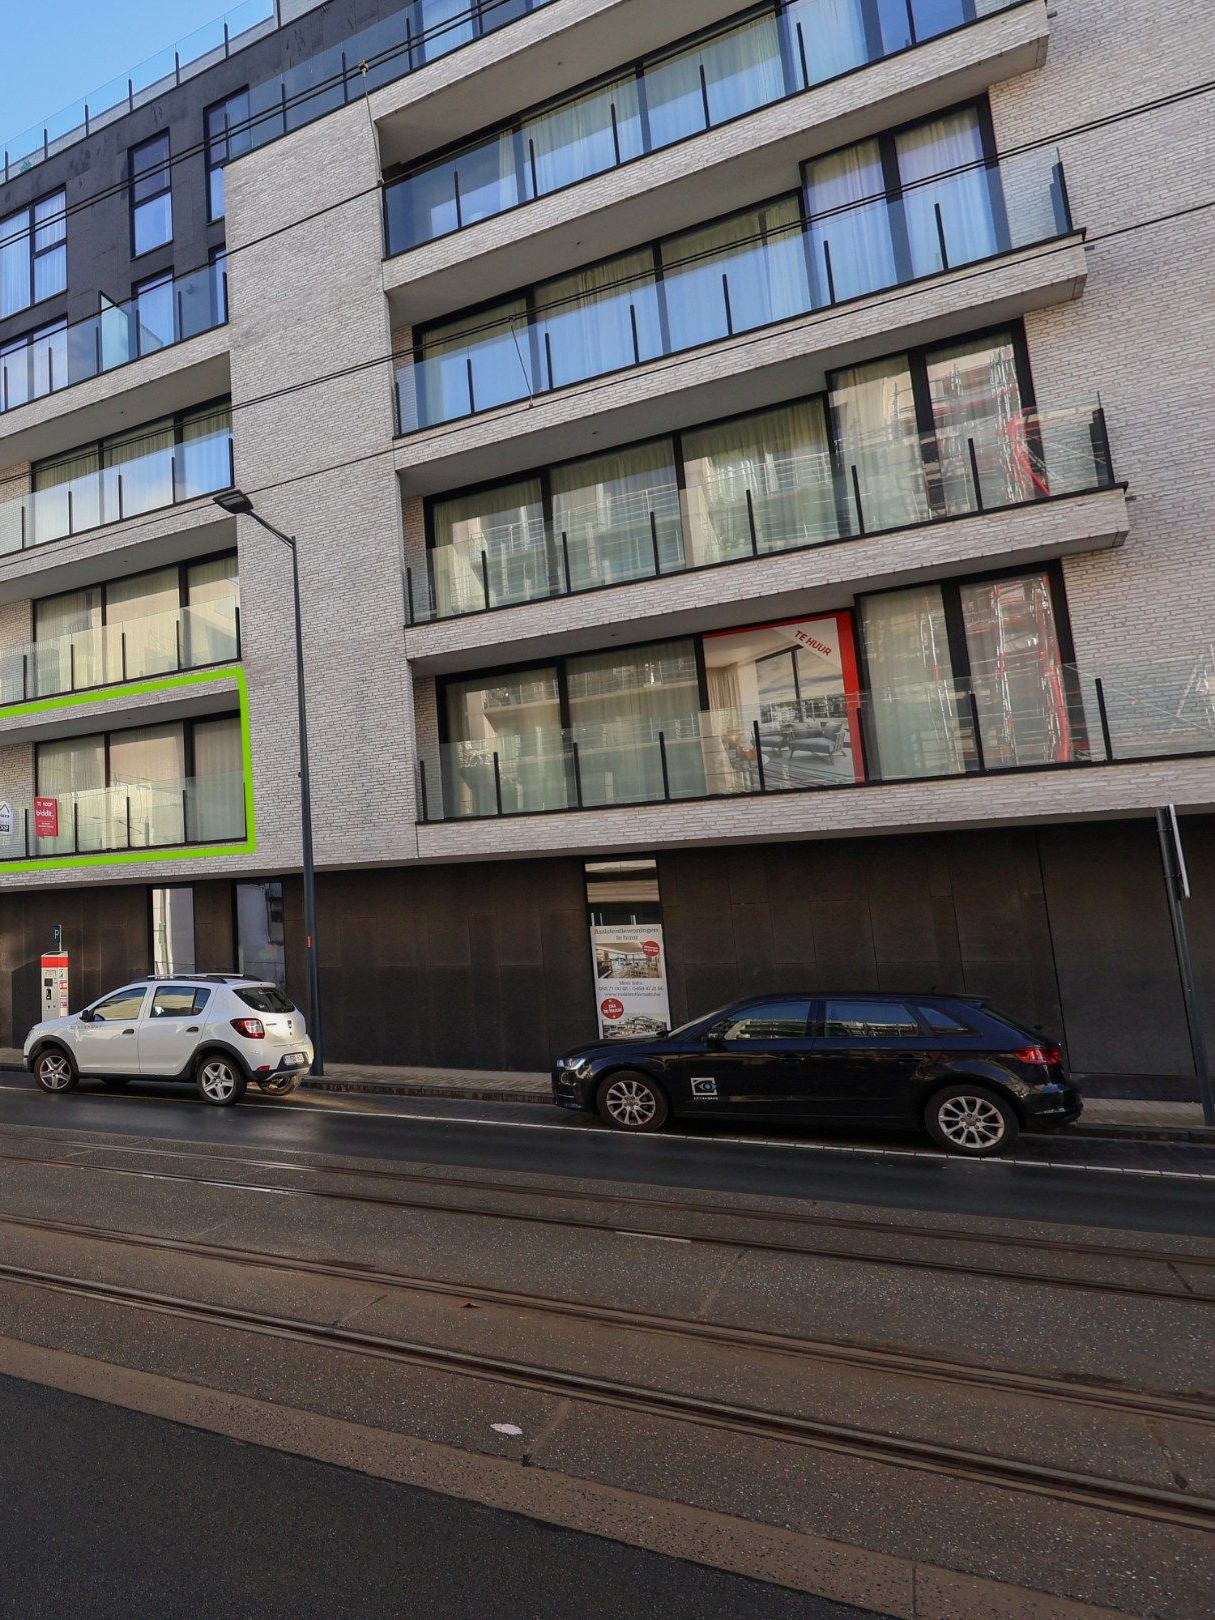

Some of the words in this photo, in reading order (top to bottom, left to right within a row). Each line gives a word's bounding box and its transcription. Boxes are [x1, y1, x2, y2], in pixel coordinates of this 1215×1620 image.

[795, 630, 807, 641] TE
[806, 637, 832, 656] HUUR
[54, 929, 60, 940] P
